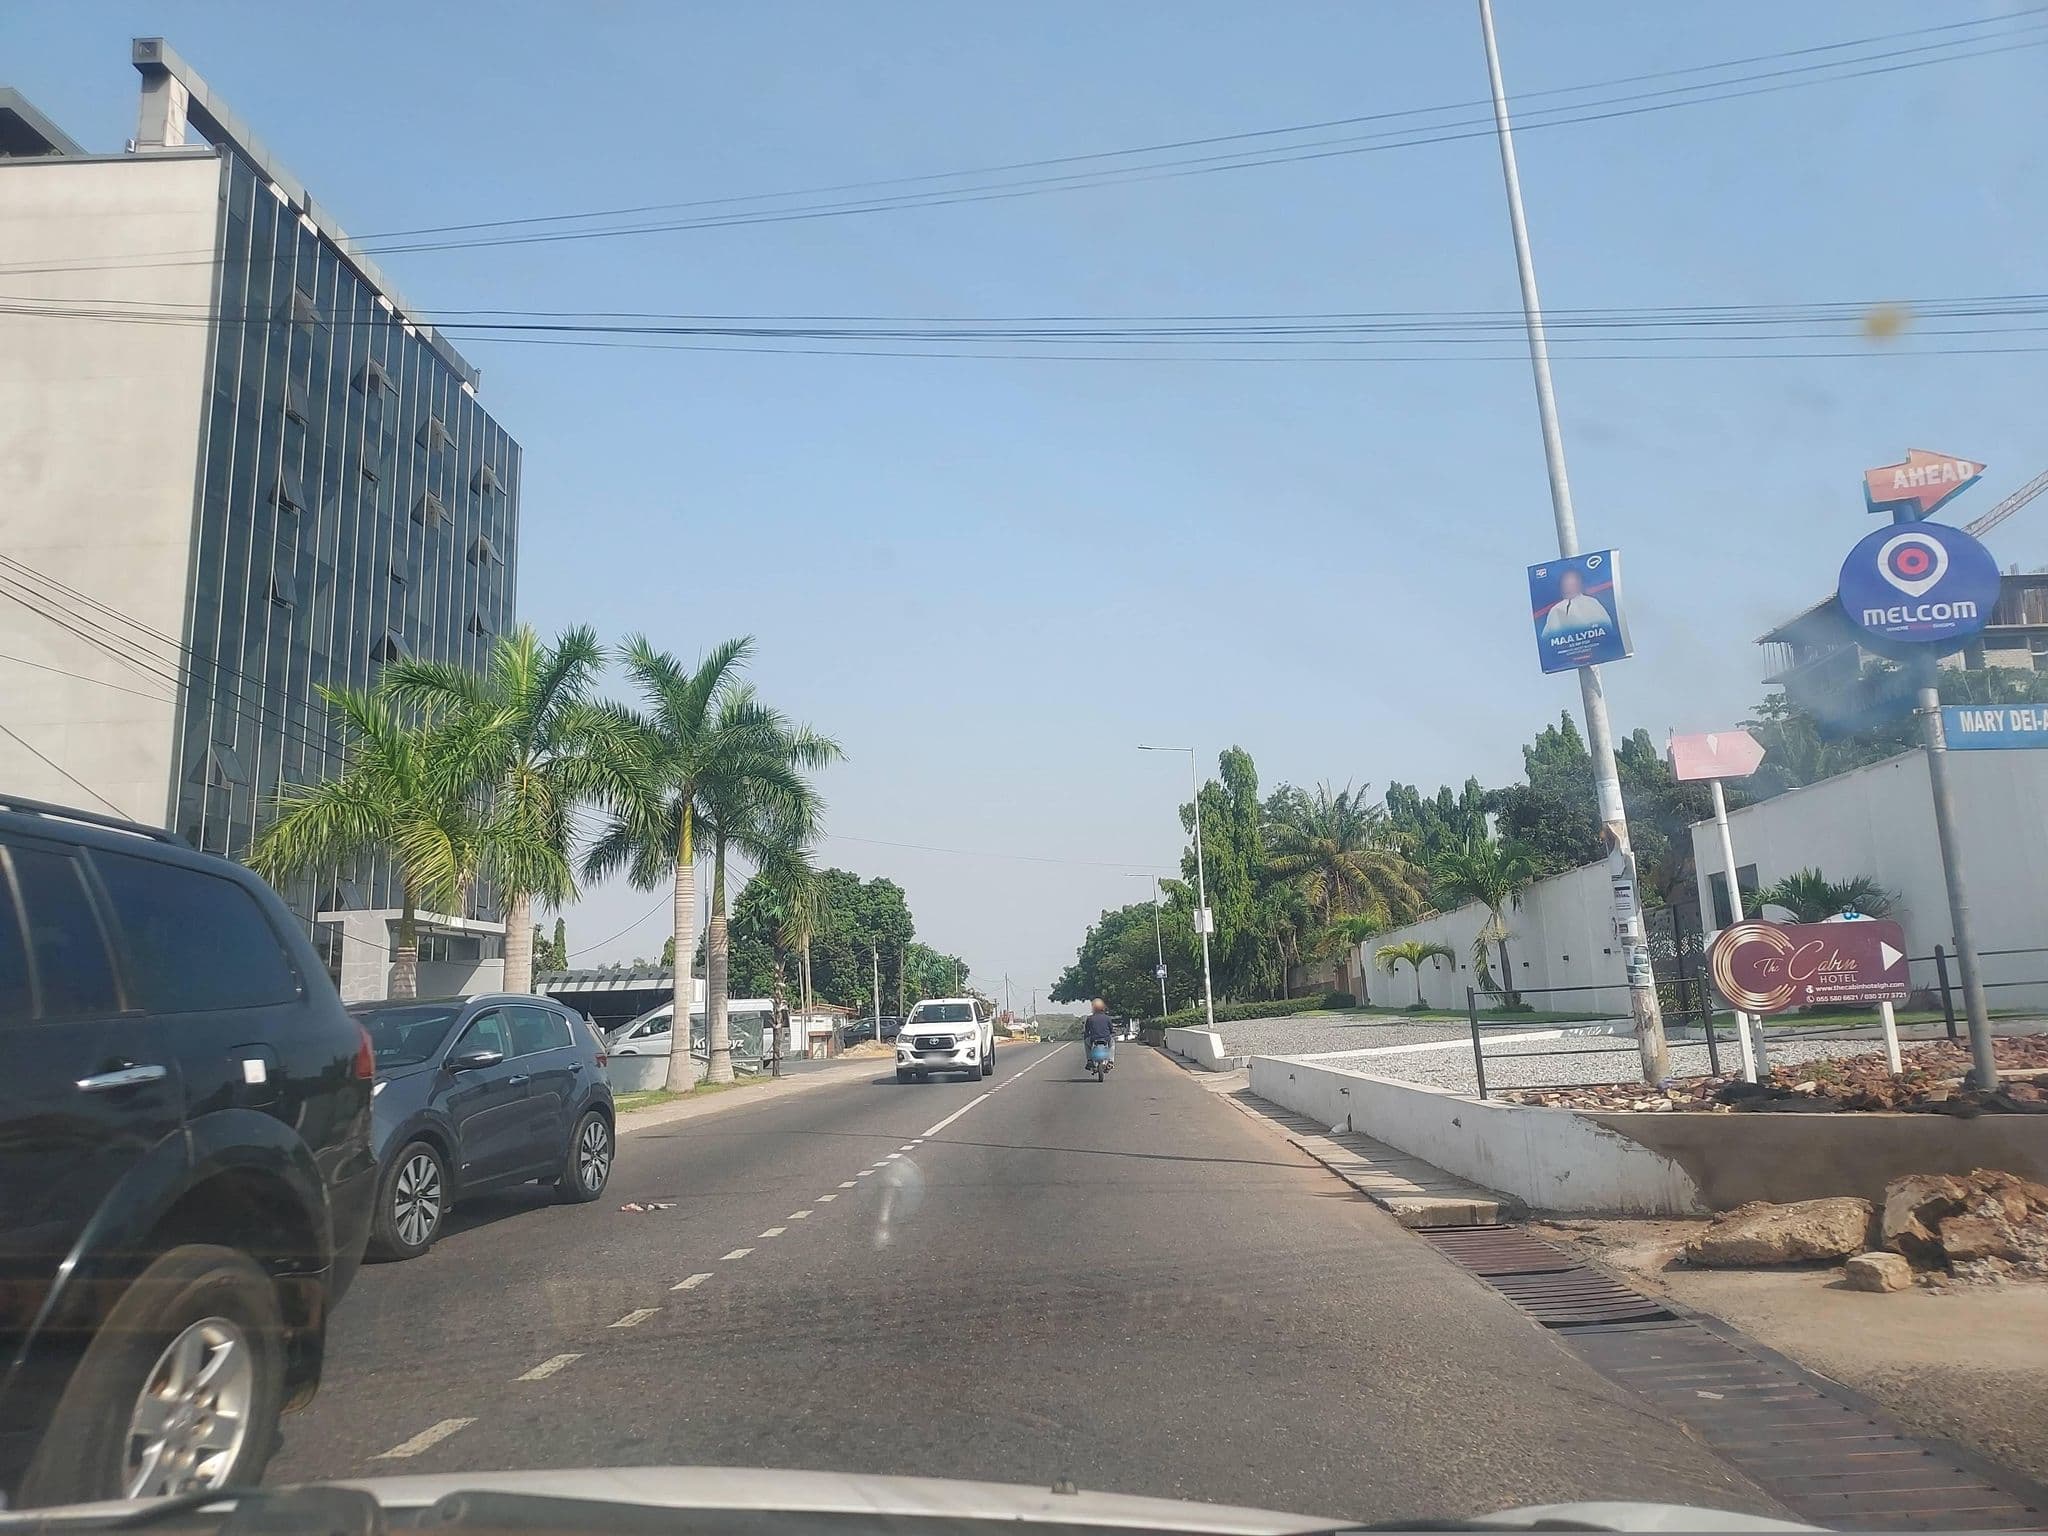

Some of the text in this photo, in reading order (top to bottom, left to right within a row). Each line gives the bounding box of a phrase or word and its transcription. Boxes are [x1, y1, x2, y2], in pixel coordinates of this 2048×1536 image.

[1893, 461, 1975, 489] AHEAD
[1863, 601, 1977, 625] MELCOM
[1551, 635, 1574, 646] MAA
[1575, 628, 1606, 641] LYDIA
[1960, 710, 2004, 732] MARY
[1753, 940, 1857, 981] The Cabin
[1820, 974, 1857, 983] HOTEL
